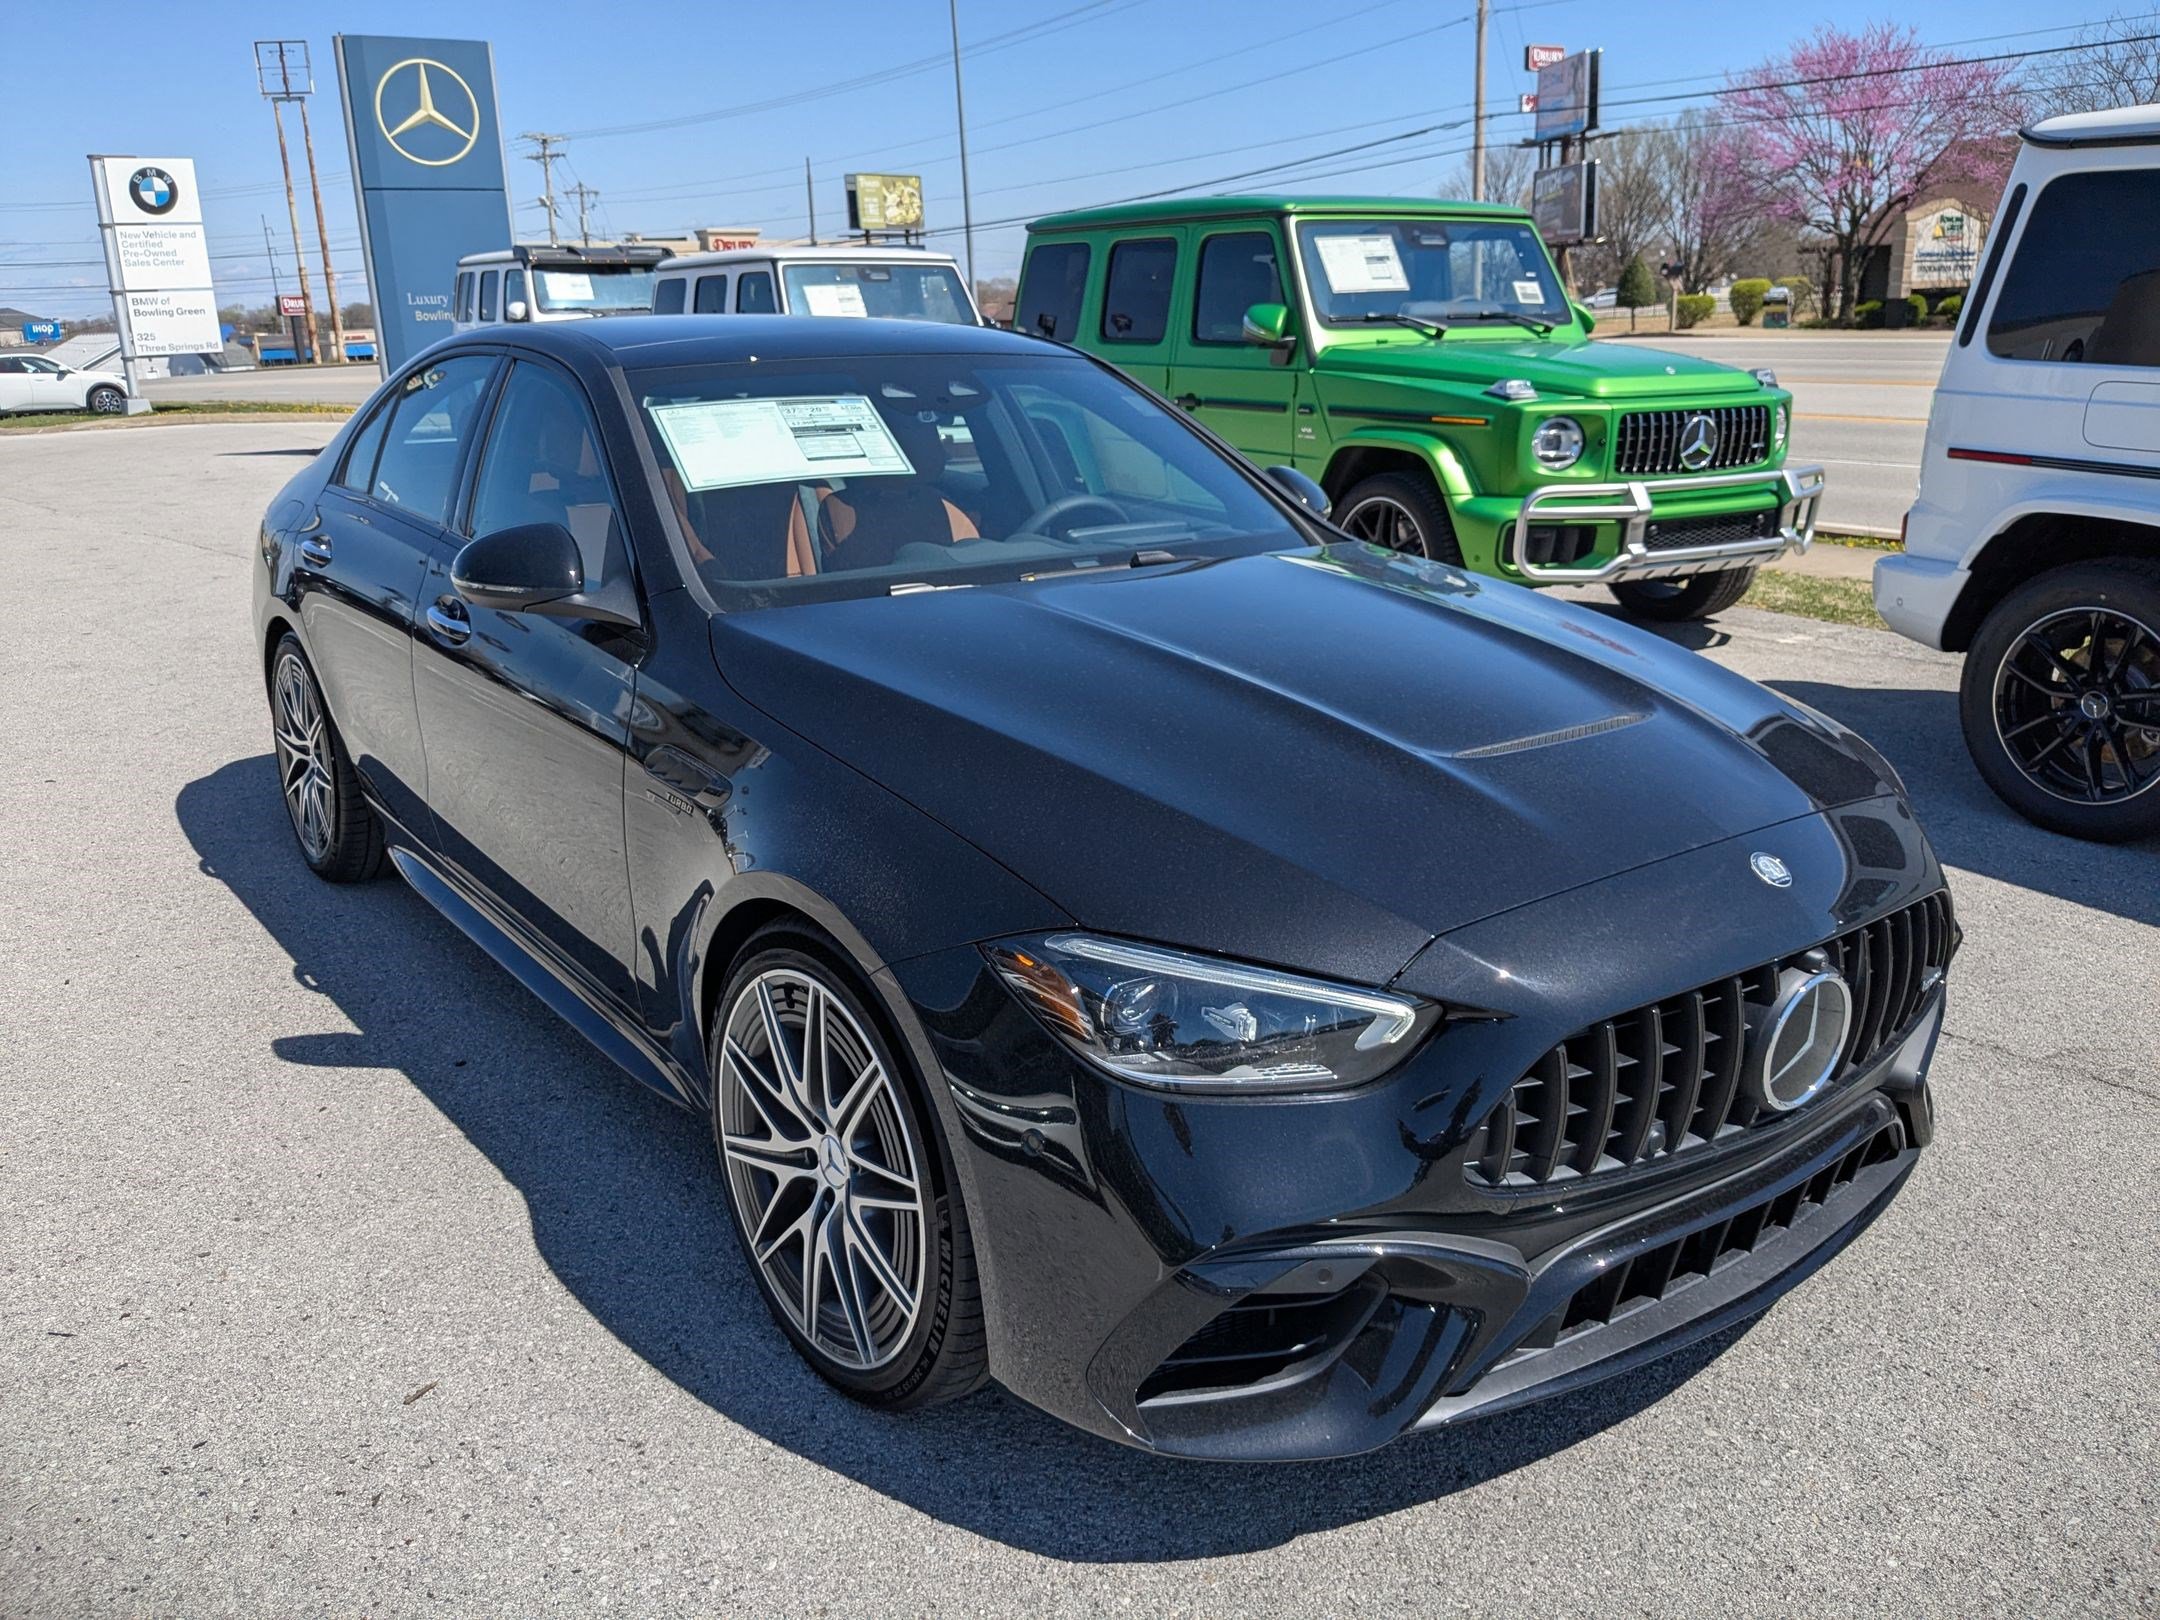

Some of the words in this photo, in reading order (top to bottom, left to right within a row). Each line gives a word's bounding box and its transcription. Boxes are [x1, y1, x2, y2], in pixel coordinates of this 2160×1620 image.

[133, 168, 173, 185] BMW
[120, 231, 141, 239] New
[142, 231, 177, 239] Vehicle
[179, 231, 197, 239] and
[121, 240, 163, 248] Certified
[123, 249, 177, 257] Pre-Owned
[125, 259, 151, 267] Sales
[153, 258, 184, 267] Center
[132, 297, 158, 306] BMW
[161, 297, 170, 305] of
[283, 298, 305, 308] DRUR
[407, 292, 448, 307] Luxury
[134, 308, 174, 318] Bowling
[176, 307, 206, 316] Green
[137, 333, 156, 341] 325
[139, 344, 166, 352] Three
[168, 343, 204, 352] Springs
[206, 341, 219, 350] Rd
[665, 792, 693, 814] TURBO
[928, 1238, 951, 1355] MICHELIN
